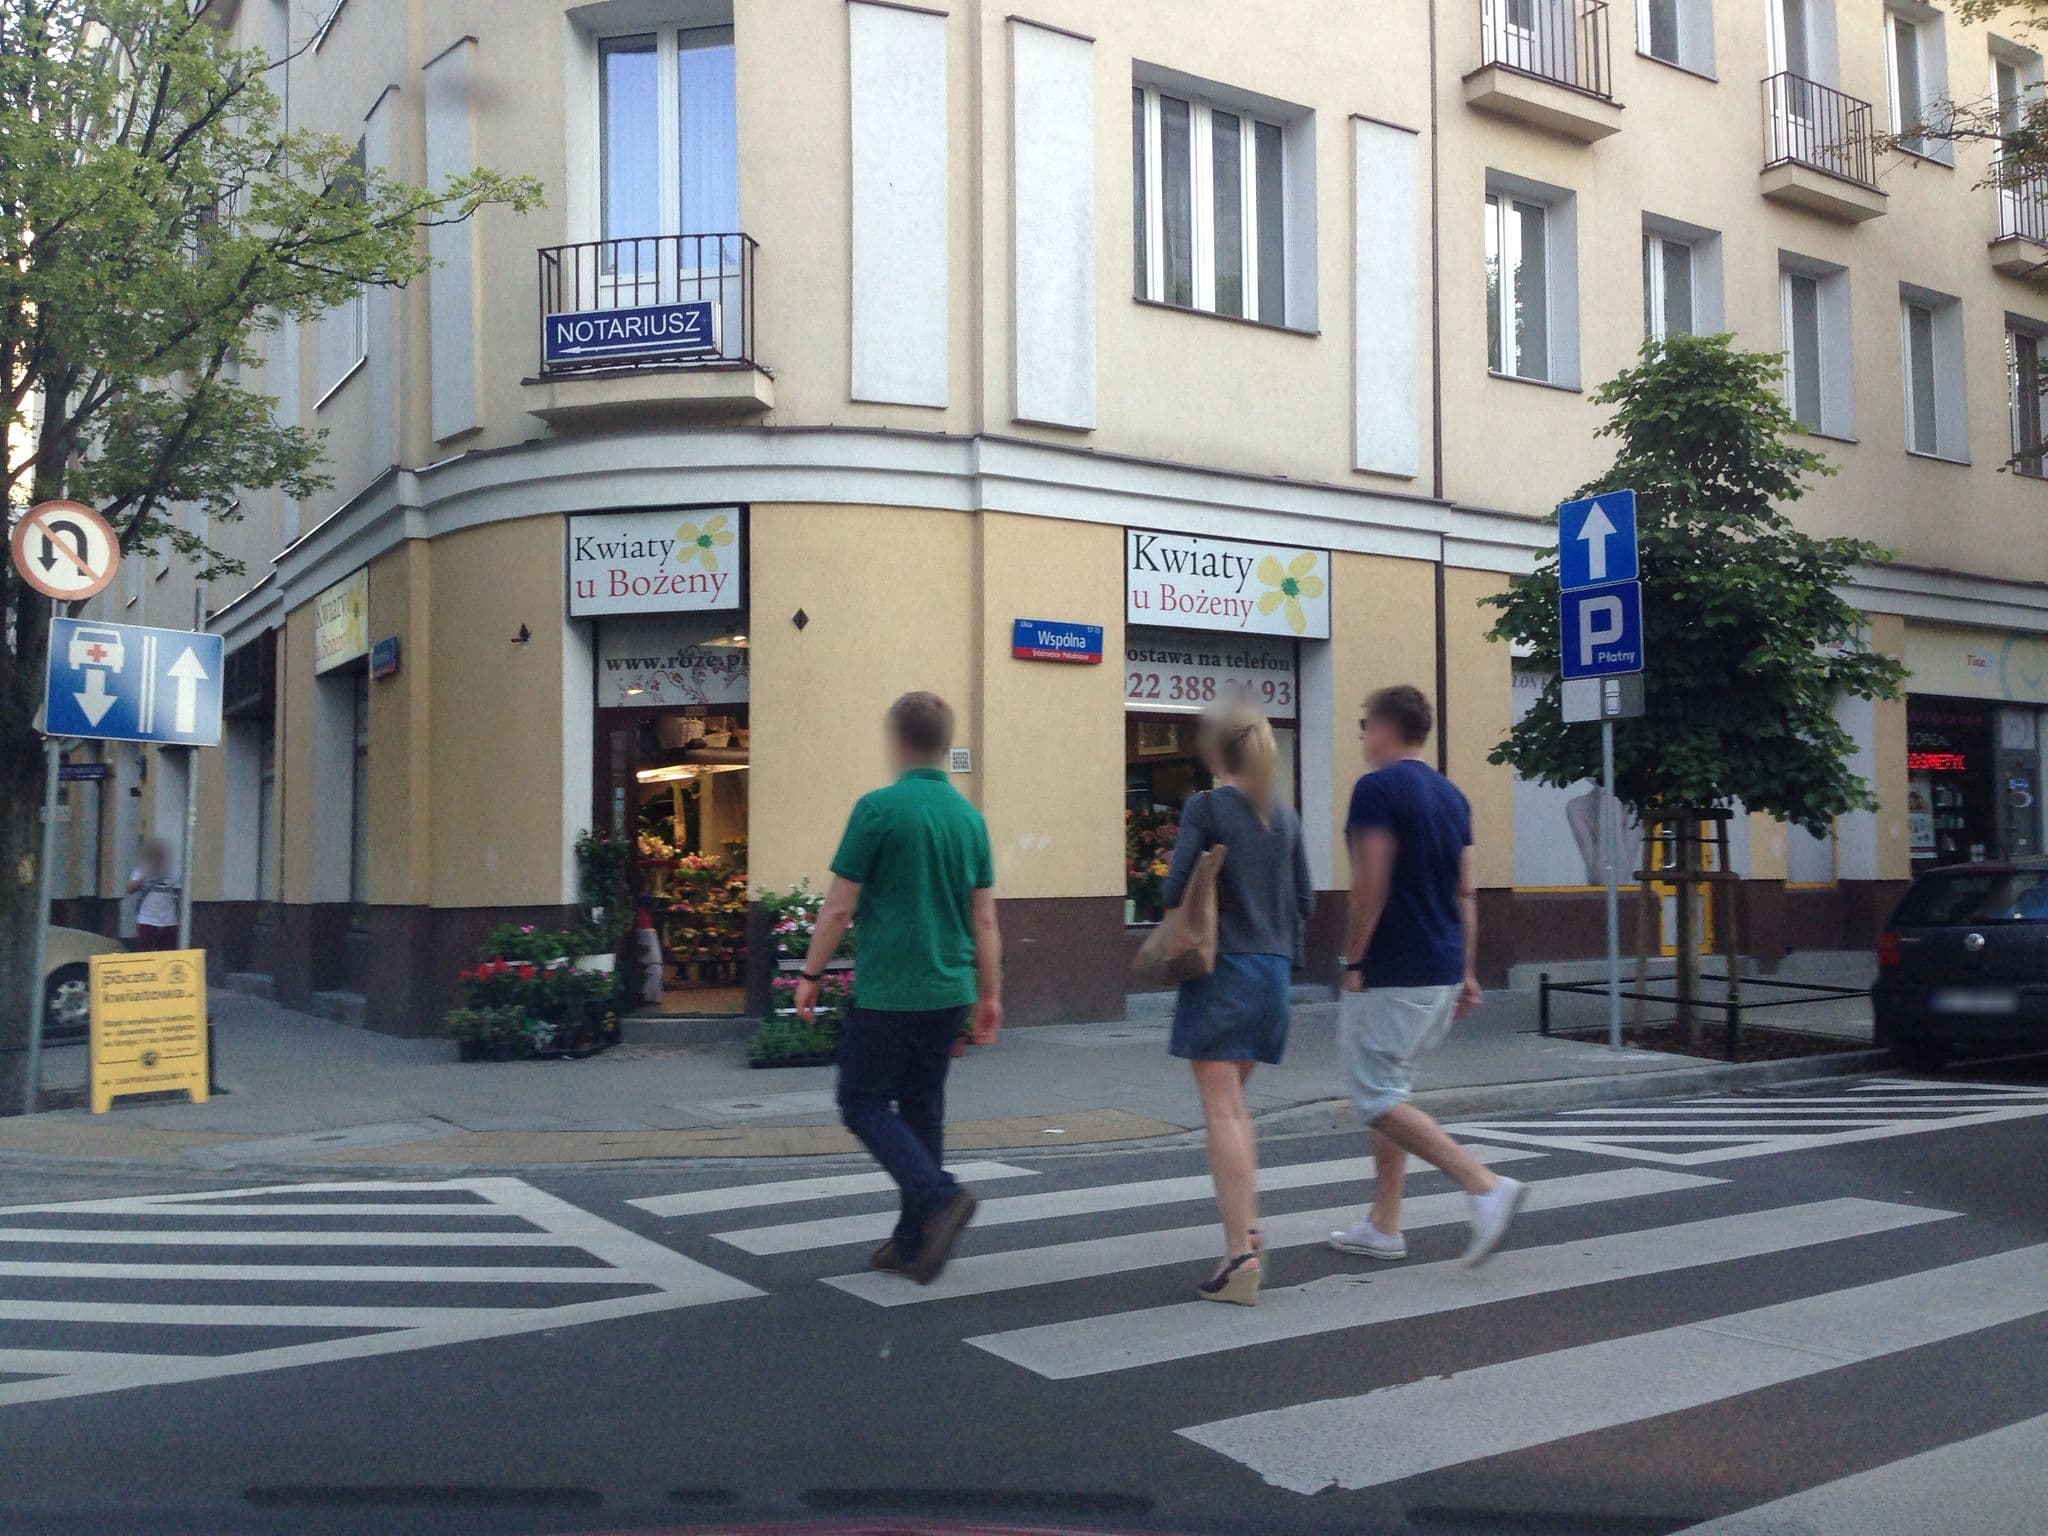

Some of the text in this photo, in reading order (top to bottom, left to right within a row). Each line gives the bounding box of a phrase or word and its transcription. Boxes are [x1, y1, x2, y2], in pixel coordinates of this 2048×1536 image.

[557, 311, 701, 344] NOTARIUSZ
[574, 532, 676, 567] Kwiaty
[1132, 533, 1255, 594] Kwiaty
[575, 568, 729, 604] u Bożeny
[1132, 582, 1255, 628] u Bożeny
[1037, 630, 1087, 650] Wspólna
[1198, 651, 1222, 668] na
[1226, 649, 1292, 672] telefon
[1597, 651, 1636, 665] Płatny
[1127, 671, 1161, 699] 22
[1168, 674, 1217, 702] 388
[1260, 680, 1292, 706] 93
